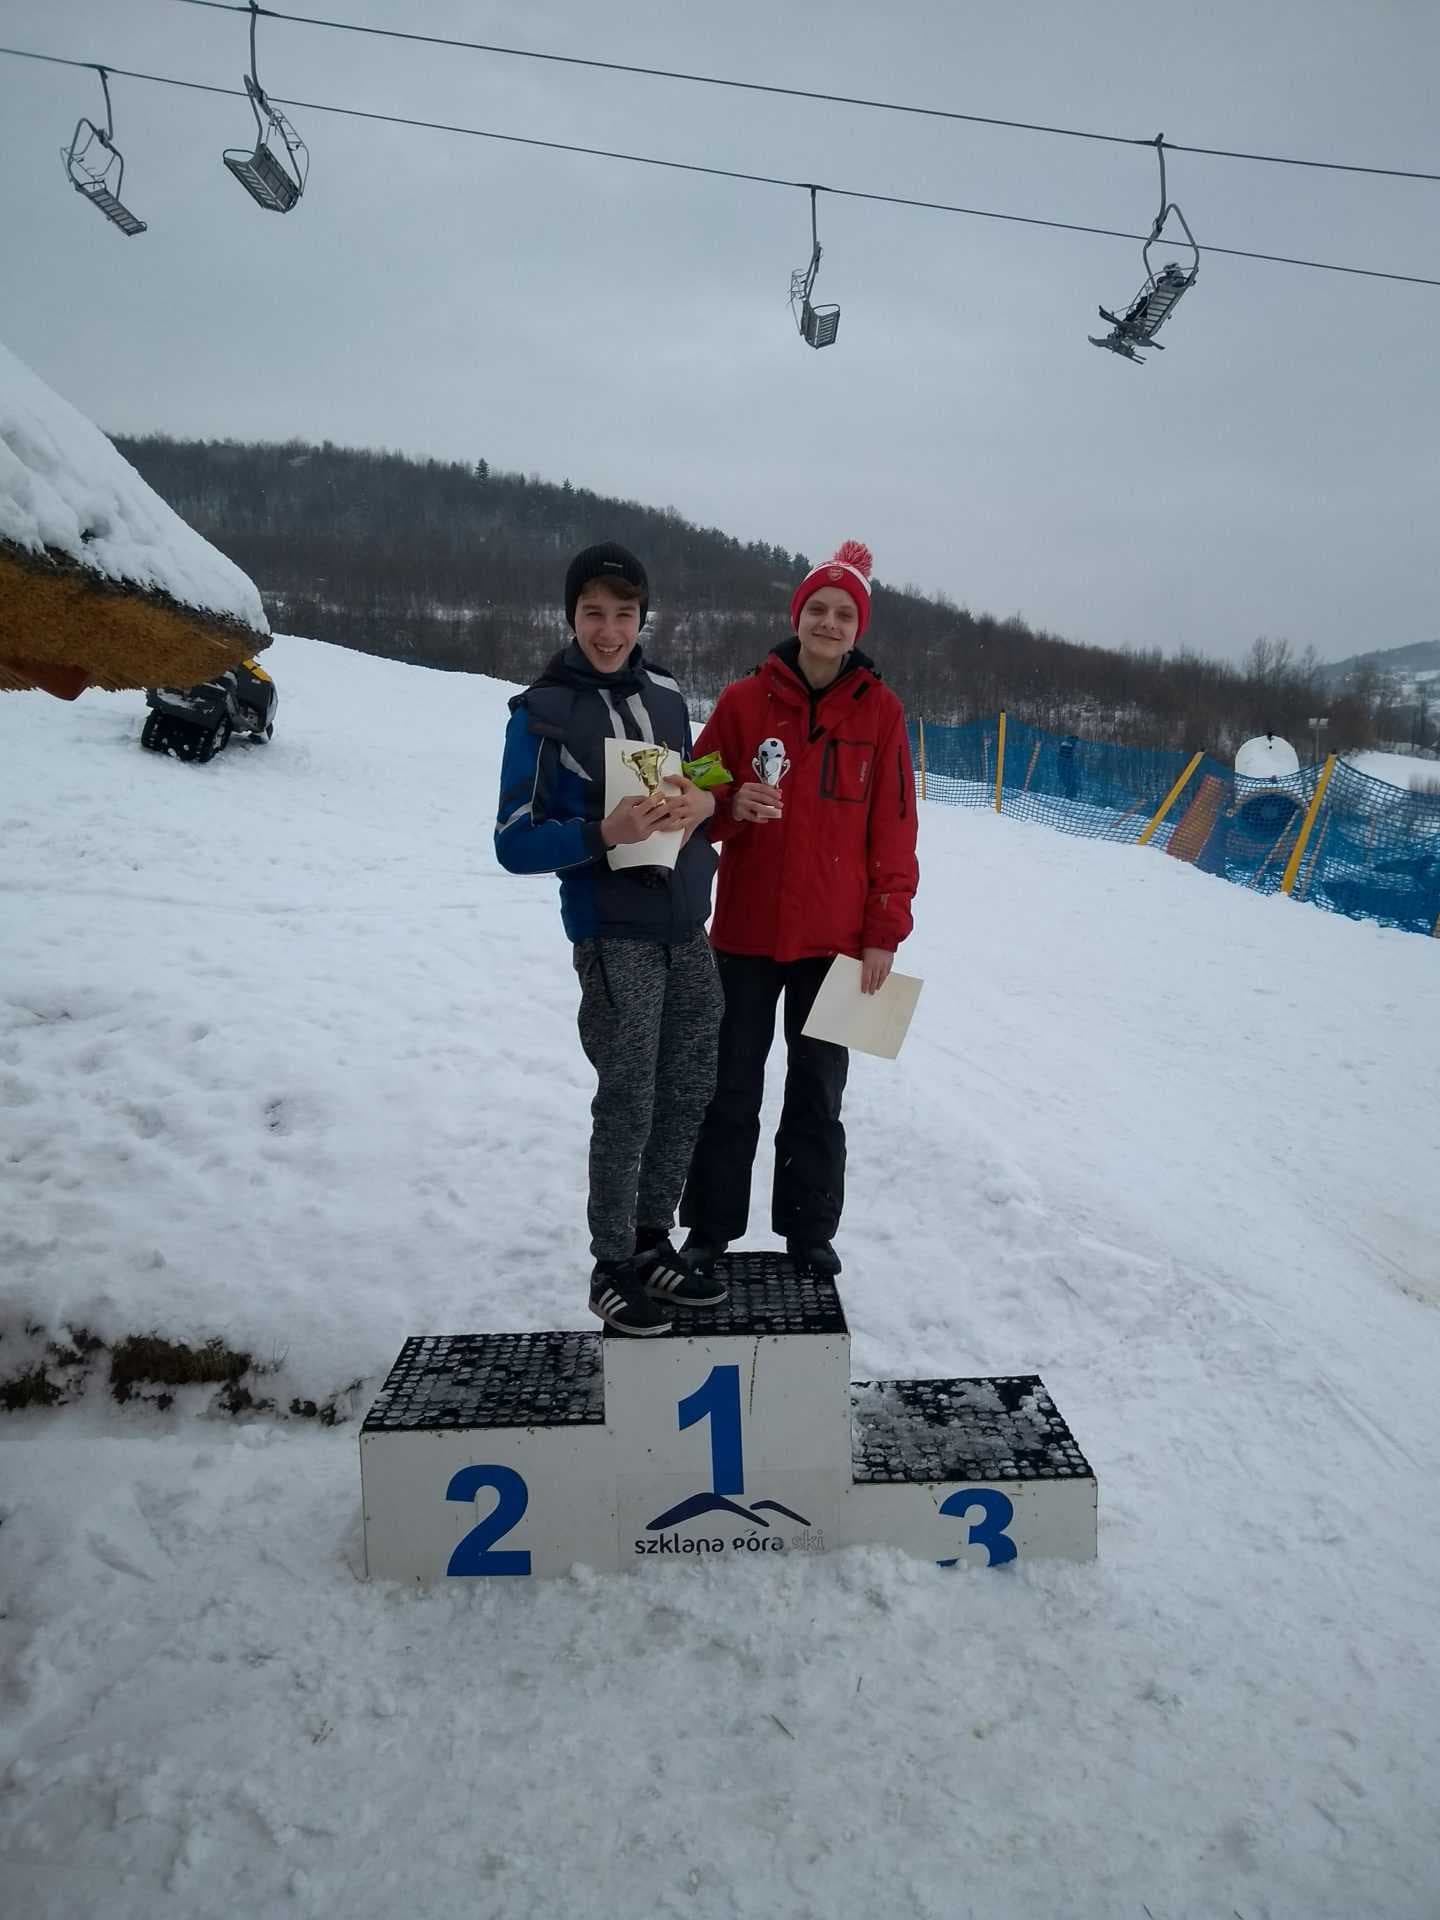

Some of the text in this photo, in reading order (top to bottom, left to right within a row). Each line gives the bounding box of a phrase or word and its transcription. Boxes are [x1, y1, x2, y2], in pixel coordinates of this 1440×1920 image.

[678, 1365, 744, 1495] 1
[446, 1464, 532, 1576] 2
[634, 1532, 724, 1555] szklana
[938, 1488, 1018, 1568] 3
